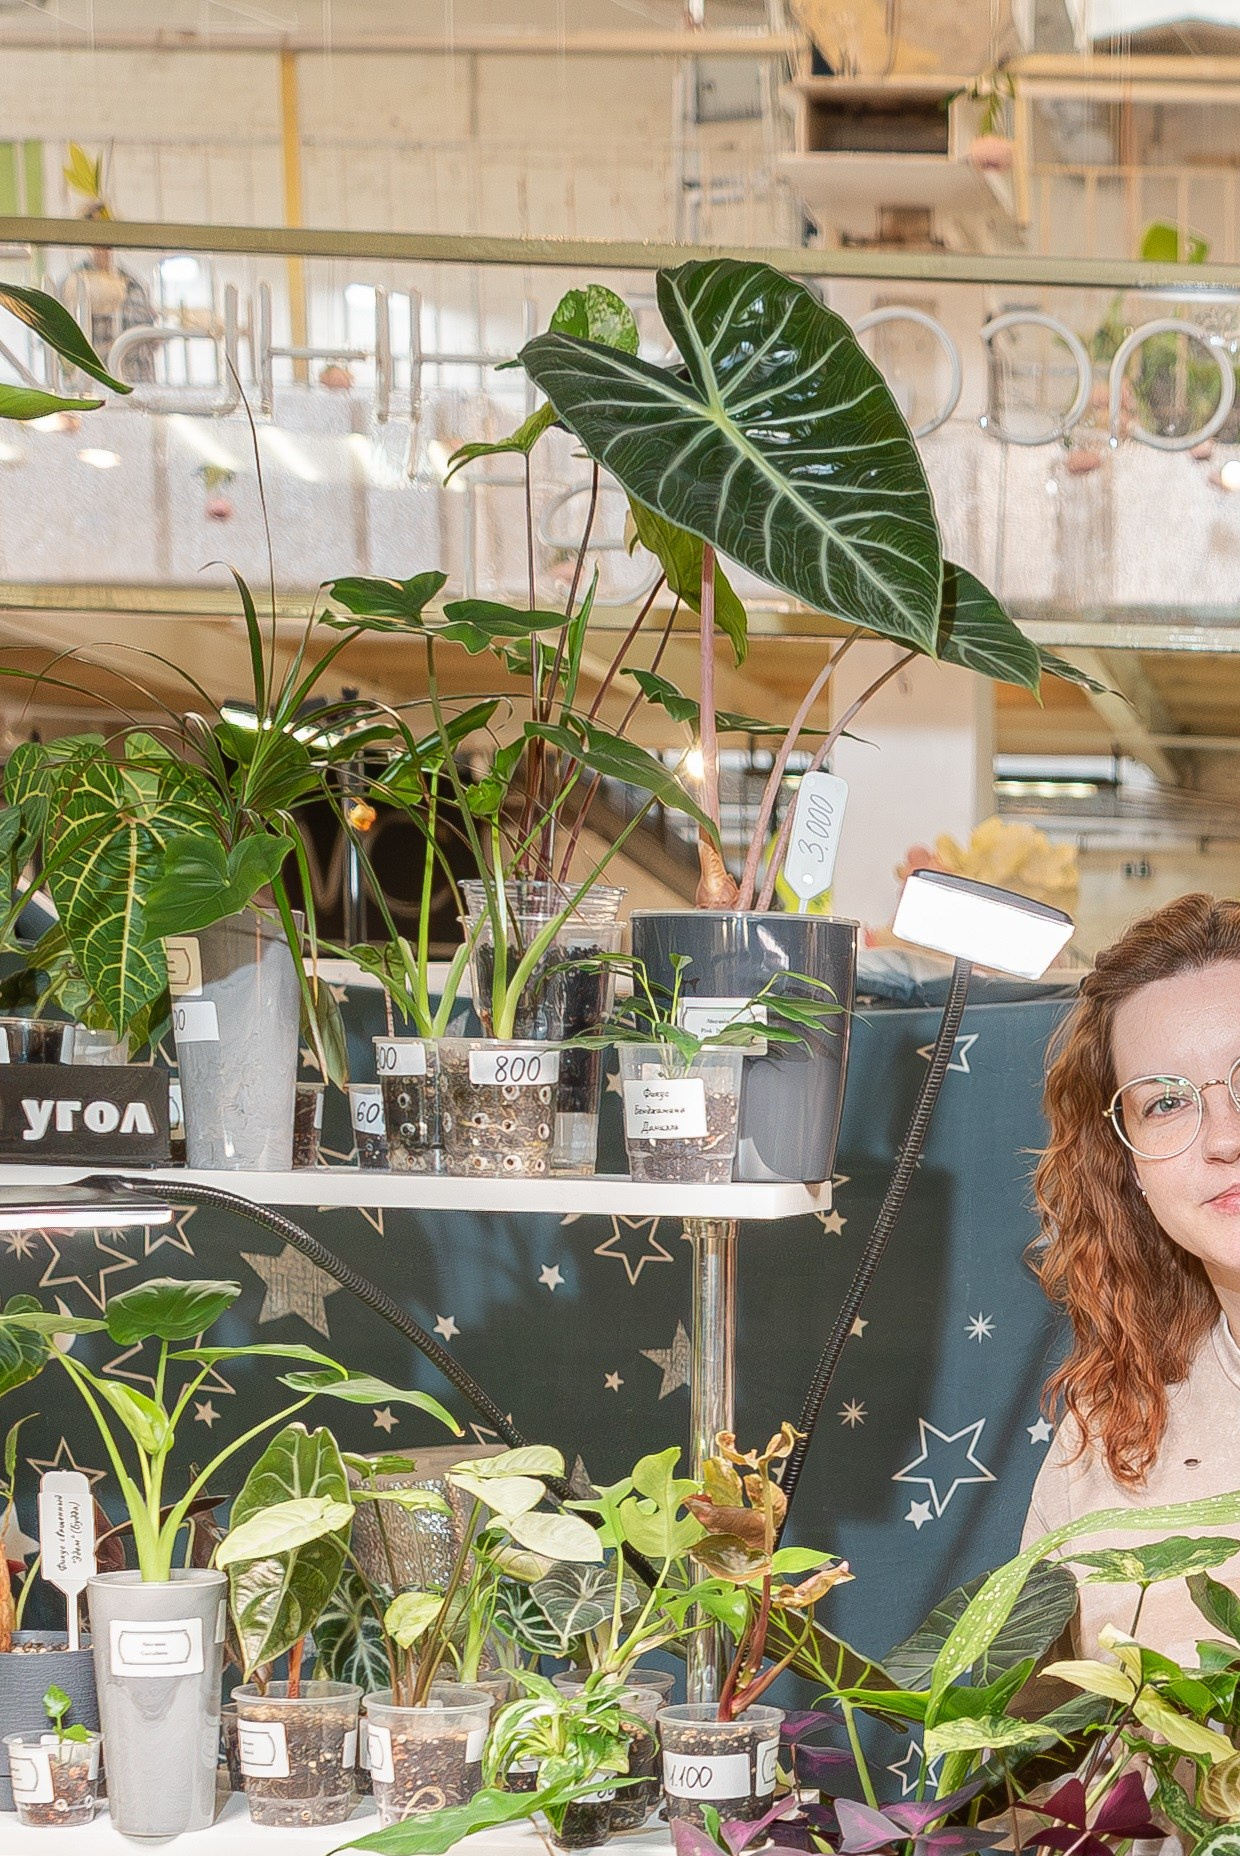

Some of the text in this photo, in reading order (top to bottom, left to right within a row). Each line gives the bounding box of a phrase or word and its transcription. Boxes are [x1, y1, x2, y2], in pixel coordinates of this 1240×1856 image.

[797, 793, 834, 863] 3.000
[376, 1046, 397, 1070] 00
[494, 1056, 541, 1083] 800
[21, 1098, 155, 1141] угол
[357, 1101, 384, 1124] 60
[668, 1765, 713, 1789] 1.100
